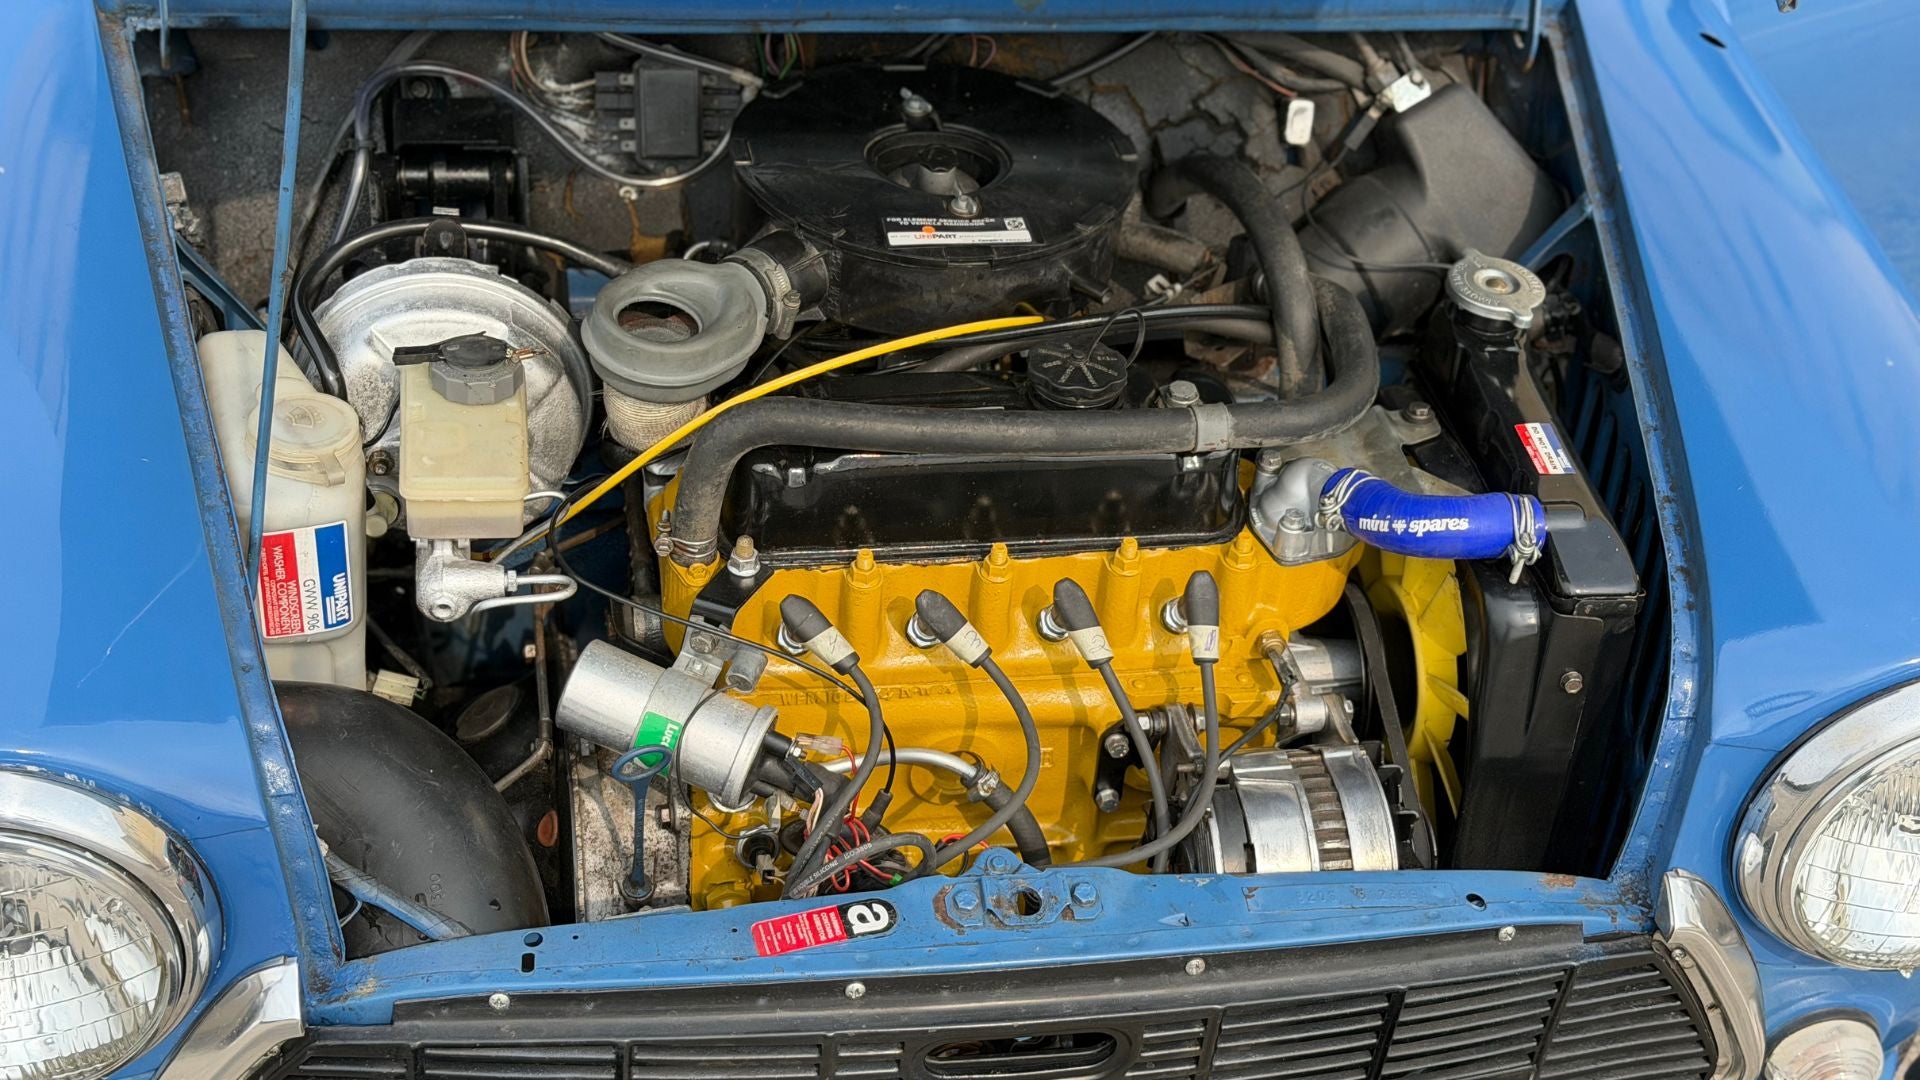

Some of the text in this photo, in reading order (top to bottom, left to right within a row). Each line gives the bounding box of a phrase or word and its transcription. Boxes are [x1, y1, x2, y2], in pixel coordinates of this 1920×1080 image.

[1531, 426, 1540, 434] DO
[1537, 437, 1548, 449] NOT
[1544, 452, 1558, 470] DRAIN
[1359, 514, 1469, 537] mini spares
[272, 545, 292, 634] WASHER COMPONENT
[287, 580, 301, 633] WINDSCREEN
[303, 579, 320, 631] GWW 906
[332, 572, 350, 621] UNIPART
[1089, 634, 1111, 654] 2
[847, 903, 889, 935] a
